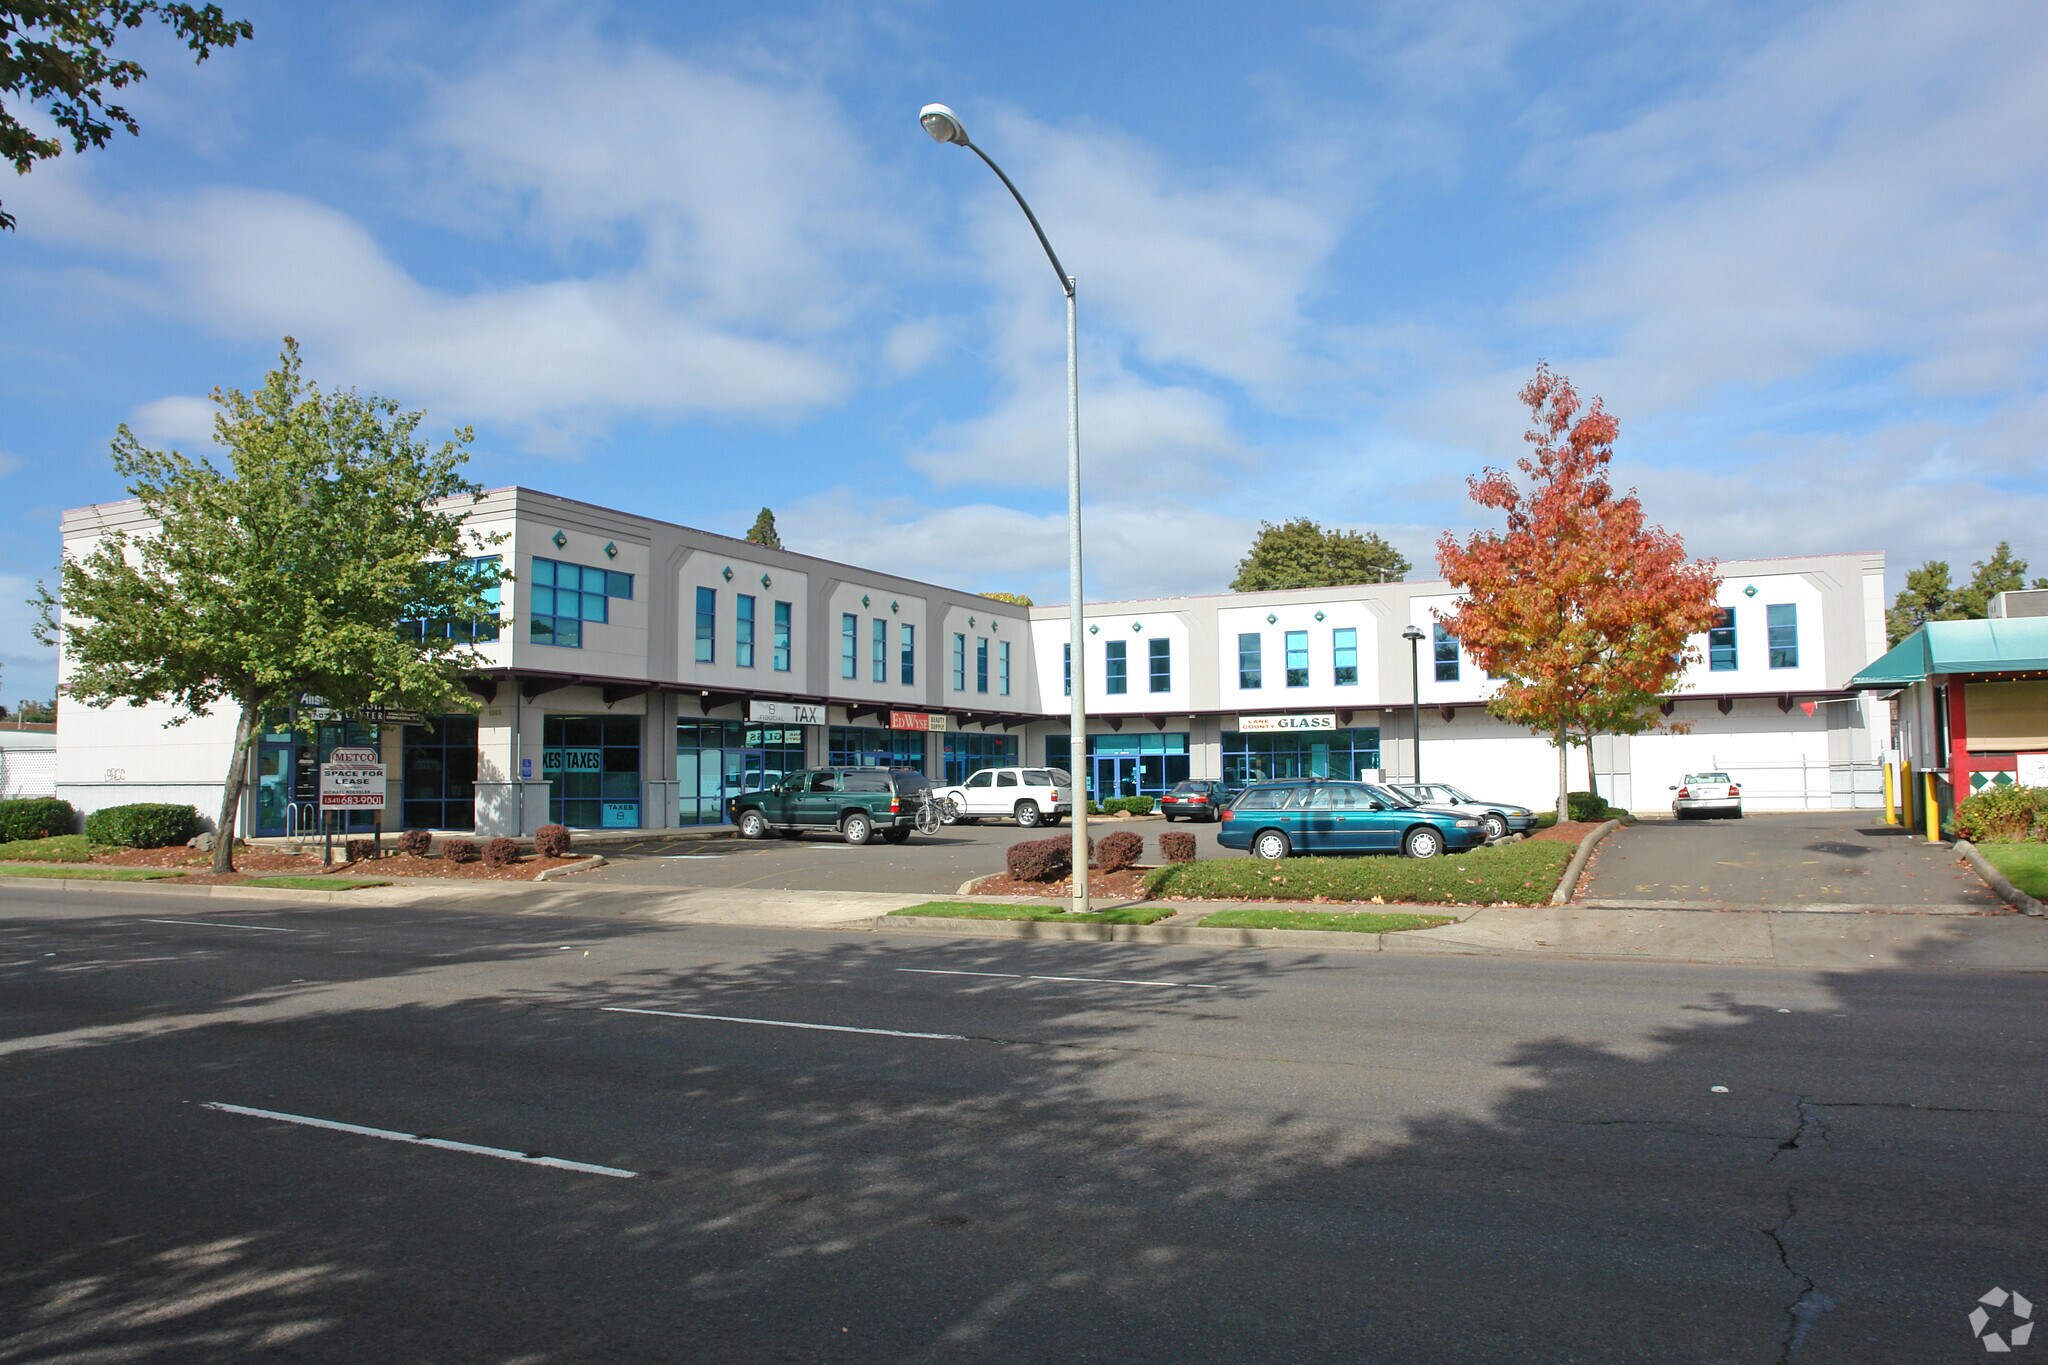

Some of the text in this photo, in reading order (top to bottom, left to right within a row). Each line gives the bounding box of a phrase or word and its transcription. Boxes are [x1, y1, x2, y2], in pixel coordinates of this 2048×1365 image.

[759, 714, 785, 722] FIDUCIAL
[792, 706, 817, 723] TAX
[930, 723, 945, 731] SUPPLY
[1277, 717, 1331, 728] GLASS
[335, 753, 375, 762] METCO
[566, 751, 600, 769] TAXES
[341, 796, 382, 805] 683-9001
